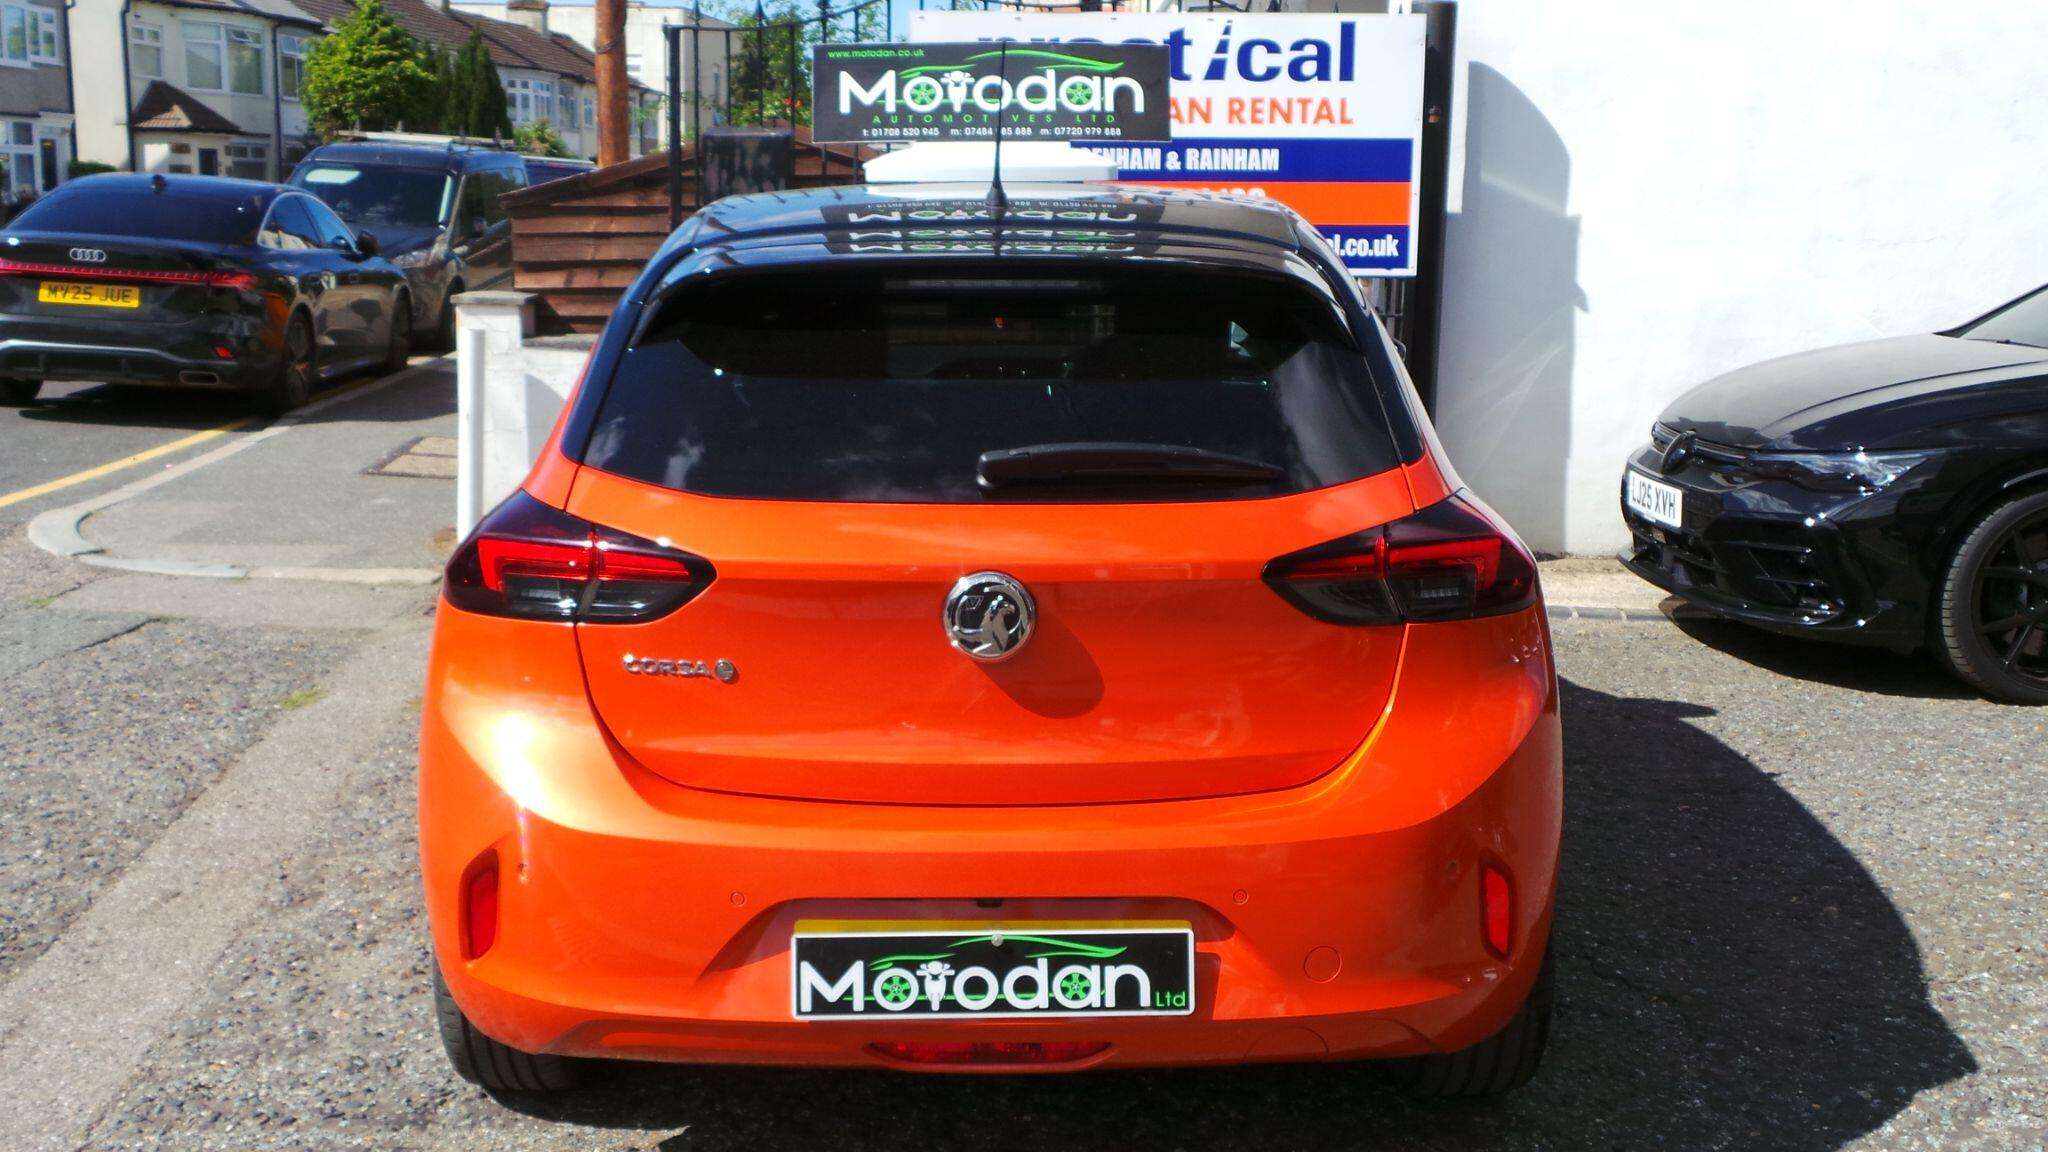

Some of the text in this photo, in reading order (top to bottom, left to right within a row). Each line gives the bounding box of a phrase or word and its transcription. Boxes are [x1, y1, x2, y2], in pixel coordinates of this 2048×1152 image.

[828, 48, 925, 58] www.motodan.co.uk
[838, 68, 1145, 114] Motodan
[871, 114, 1115, 124] AUTOMOTVES LTD
[1169, 96, 1354, 124] AN RENTAL
[871, 128, 900, 137] 01708
[902, 127, 920, 136] 520
[922, 127, 940, 136] 945
[950, 128, 962, 136] m:
[995, 127, 1013, 136] 85
[1040, 128, 1052, 136] m:
[1054, 127, 1083, 136] 07720
[1085, 127, 1102, 136] 979
[1165, 151, 1181, 170] &
[1186, 148, 1280, 171] RAINHAM
[100, 286, 132, 303] JUE
[1654, 486, 1676, 519] XVH
[623, 653, 711, 676] CORSA
[800, 957, 1186, 1012] Motodan Ltd
